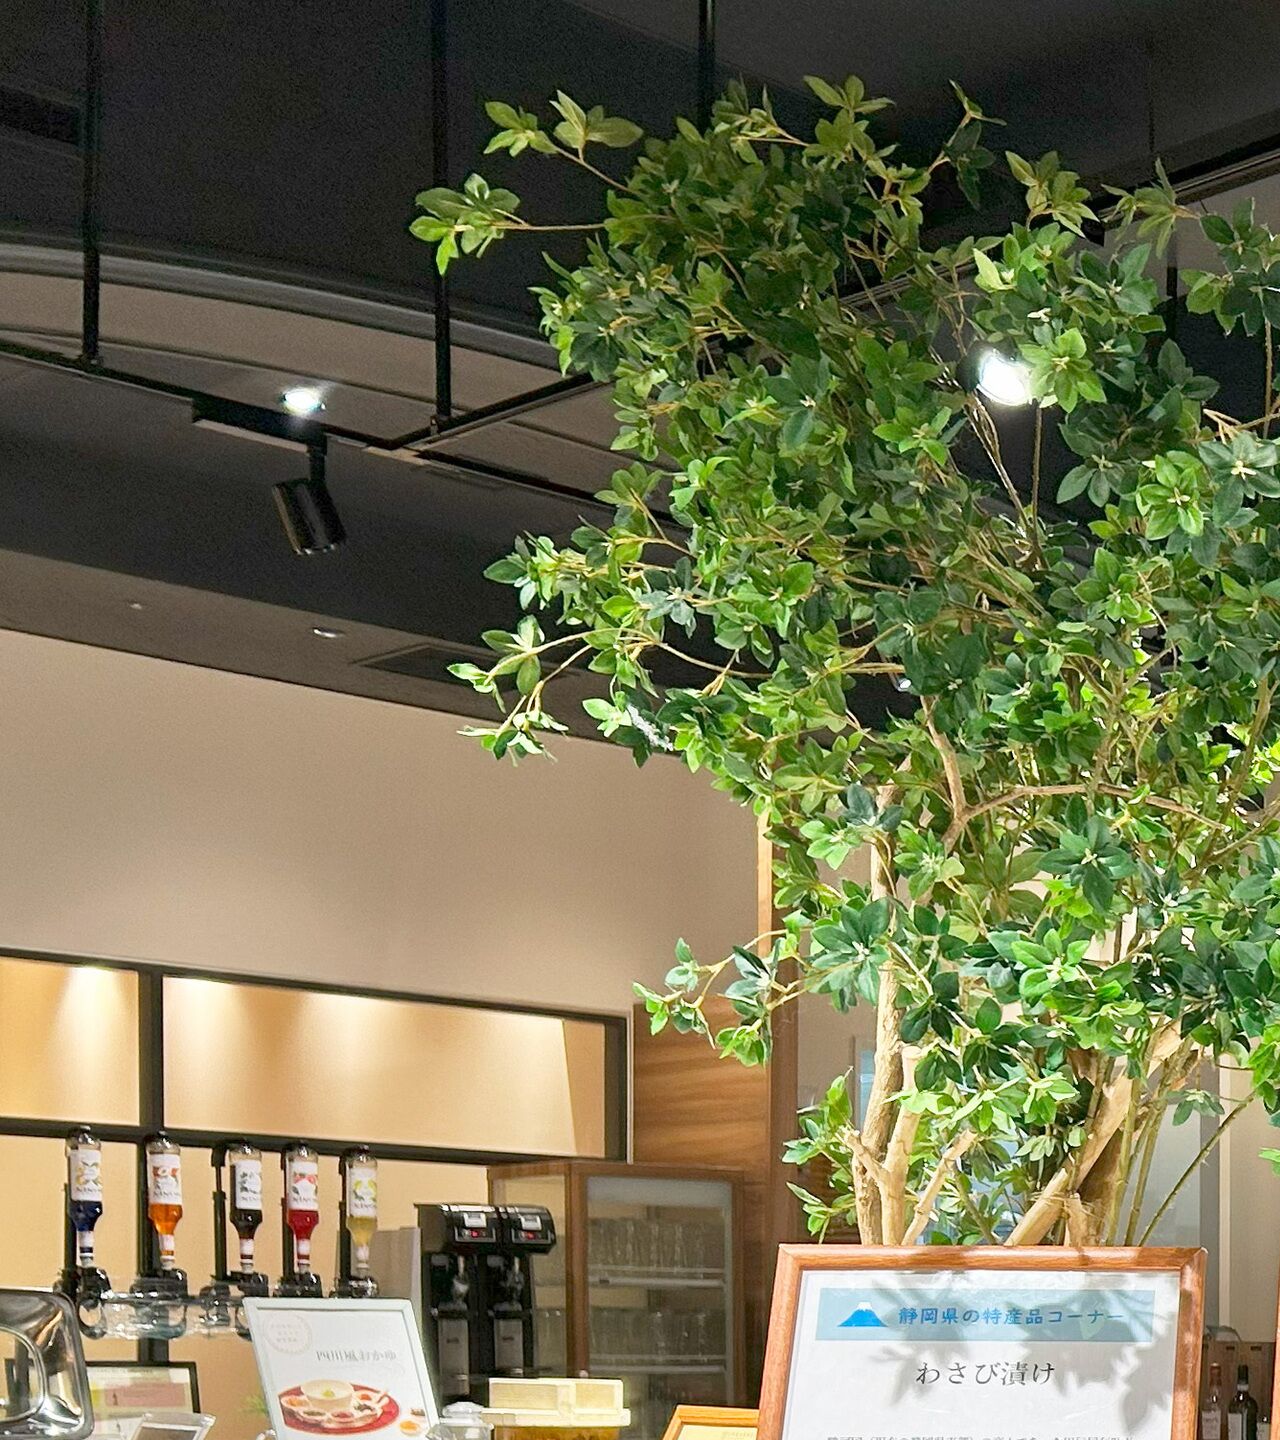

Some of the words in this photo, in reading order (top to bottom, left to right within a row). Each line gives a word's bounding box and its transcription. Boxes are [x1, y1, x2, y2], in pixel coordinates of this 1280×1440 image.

[899, 1307, 1124, 1326] 静岡県の特産品コーナー
[916, 1361, 1056, 1387] わさび漬け
